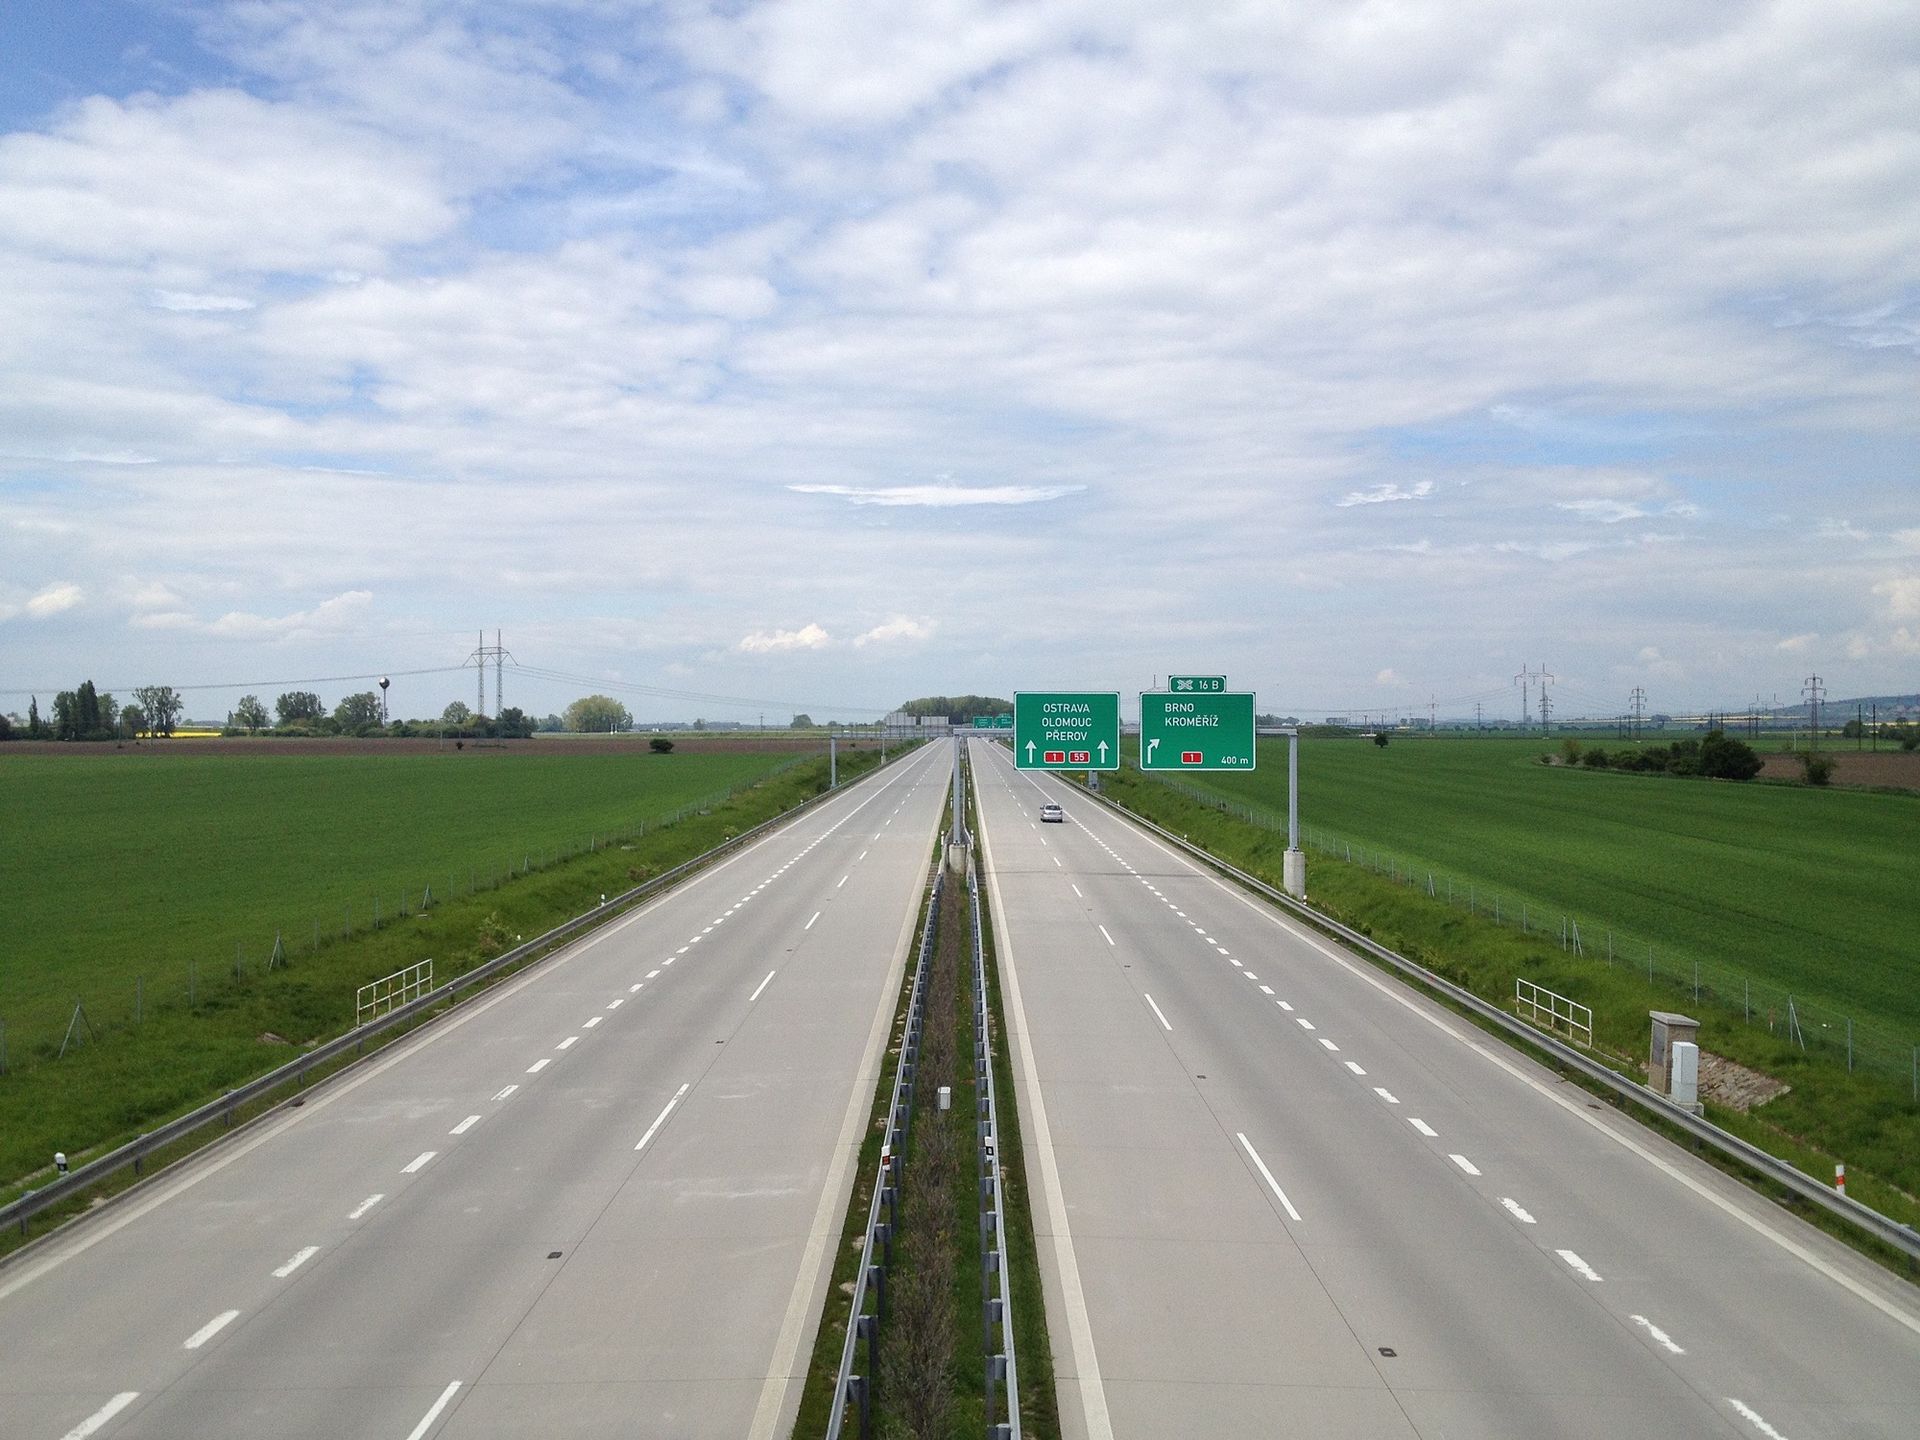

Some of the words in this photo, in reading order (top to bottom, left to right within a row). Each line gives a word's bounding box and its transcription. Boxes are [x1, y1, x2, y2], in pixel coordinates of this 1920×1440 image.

[1199, 680, 1208, 690] 16
[1212, 680, 1219, 690] B
[1043, 704, 1090, 712] OSTRAVA
[1165, 703, 1194, 712] BRNO
[1042, 717, 1092, 727] OLOMOUC
[1165, 714, 1219, 726] KROMĚŘÍŽ
[1046, 729, 1088, 741] PŘEROV
[1074, 753, 1084, 761] 55
[1221, 756, 1237, 764] 400
